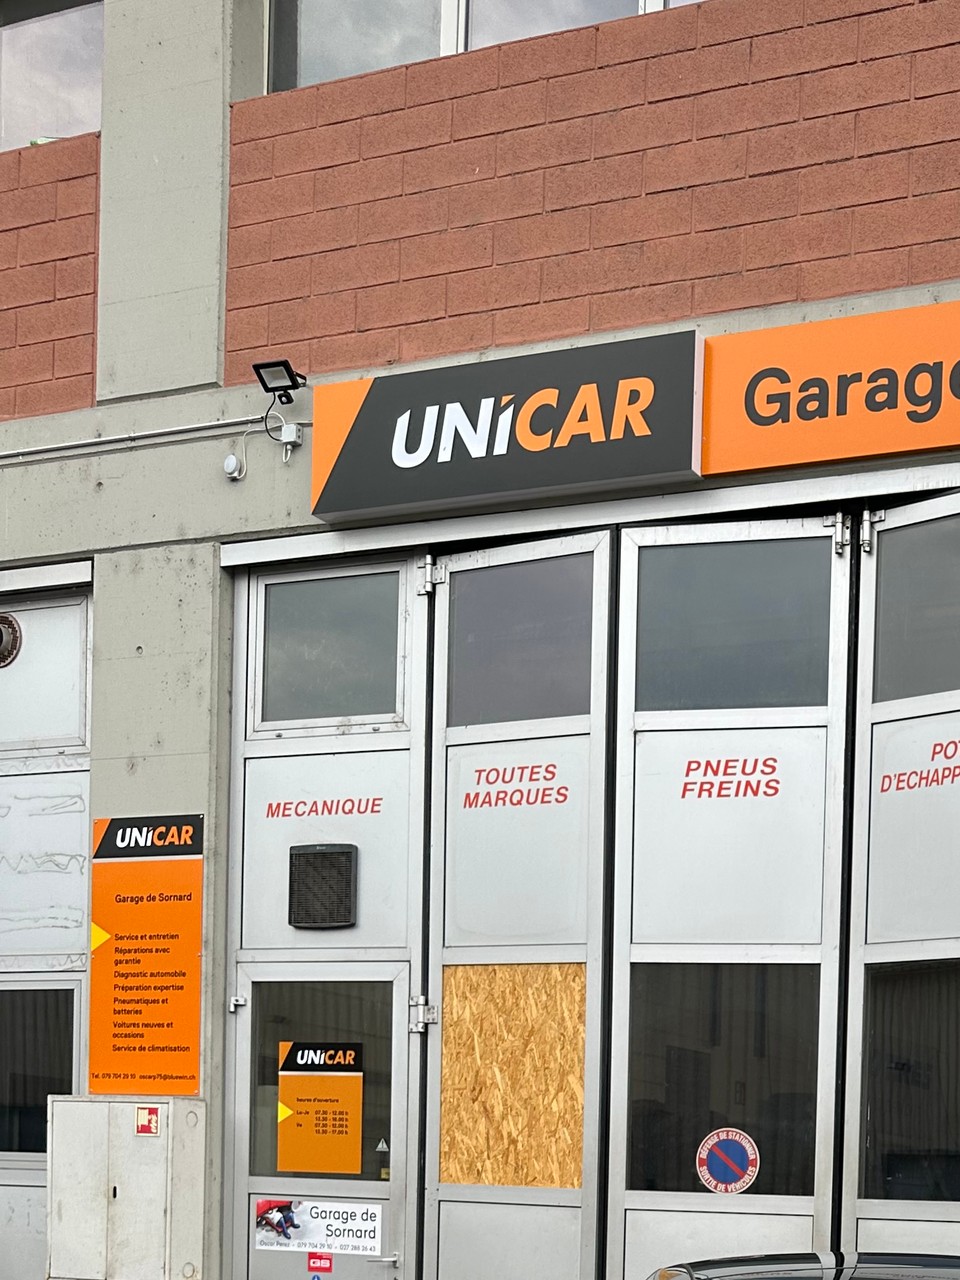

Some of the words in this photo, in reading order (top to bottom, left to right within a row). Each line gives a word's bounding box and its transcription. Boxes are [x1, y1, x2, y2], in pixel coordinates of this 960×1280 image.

[685, 757, 778, 778] PNEUS
[474, 763, 557, 786] TOUTES
[680, 778, 780, 799] FREINS
[462, 786, 569, 809] MARQUES
[265, 797, 384, 819] MECANIQUE
[115, 894, 144, 904] Garage
[146, 893, 156, 903] de
[158, 892, 192, 902] Sornard
[114, 933, 138, 941] Service
[148, 932, 180, 941] entretien
[114, 946, 154, 956] Réparations
[154, 947, 170, 955] avec
[114, 957, 142, 966] garantie
[114, 970, 148, 980] Diagnostic
[150, 970, 186, 978] automobile
[114, 983, 152, 994] Préparation
[153, 984, 184, 993] expertise
[113, 997, 160, 1007] Pneumatiques
[160, 998, 168, 1006] et
[113, 1008, 142, 1016] batteries
[112, 1021, 140, 1029] Voitures
[112, 1031, 144, 1039] occasions
[112, 1044, 137, 1052] Service
[138, 1044, 146, 1052] de
[147, 1044, 190, 1052] climatisation
[719, 1132, 728, 1140] DE
[728, 1132, 756, 1160] STATIONNER
[700, 1166, 716, 1188] SORTIE
[716, 1184, 726, 1192] DE
[309, 1205, 358, 1224] Garage
[360, 1206, 377, 1222] de
[325, 1224, 376, 1240] Sornard
